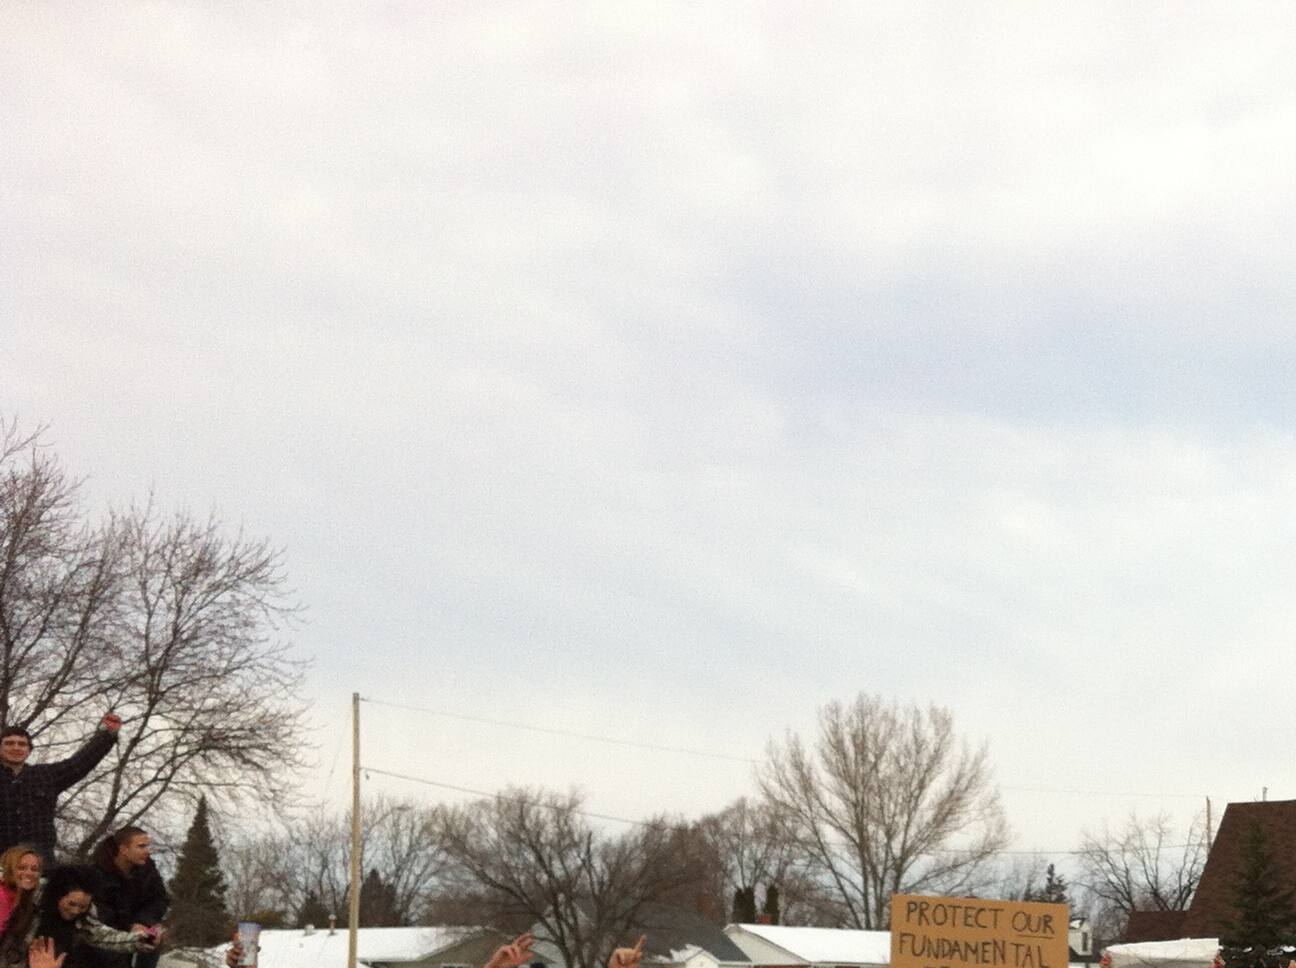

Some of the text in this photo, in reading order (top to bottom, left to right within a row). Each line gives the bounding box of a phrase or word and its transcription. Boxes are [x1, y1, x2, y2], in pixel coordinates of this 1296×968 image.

[905, 900, 1055, 935] PROTECT OUR
[899, 932, 1050, 968] FUNDAMENTAL
